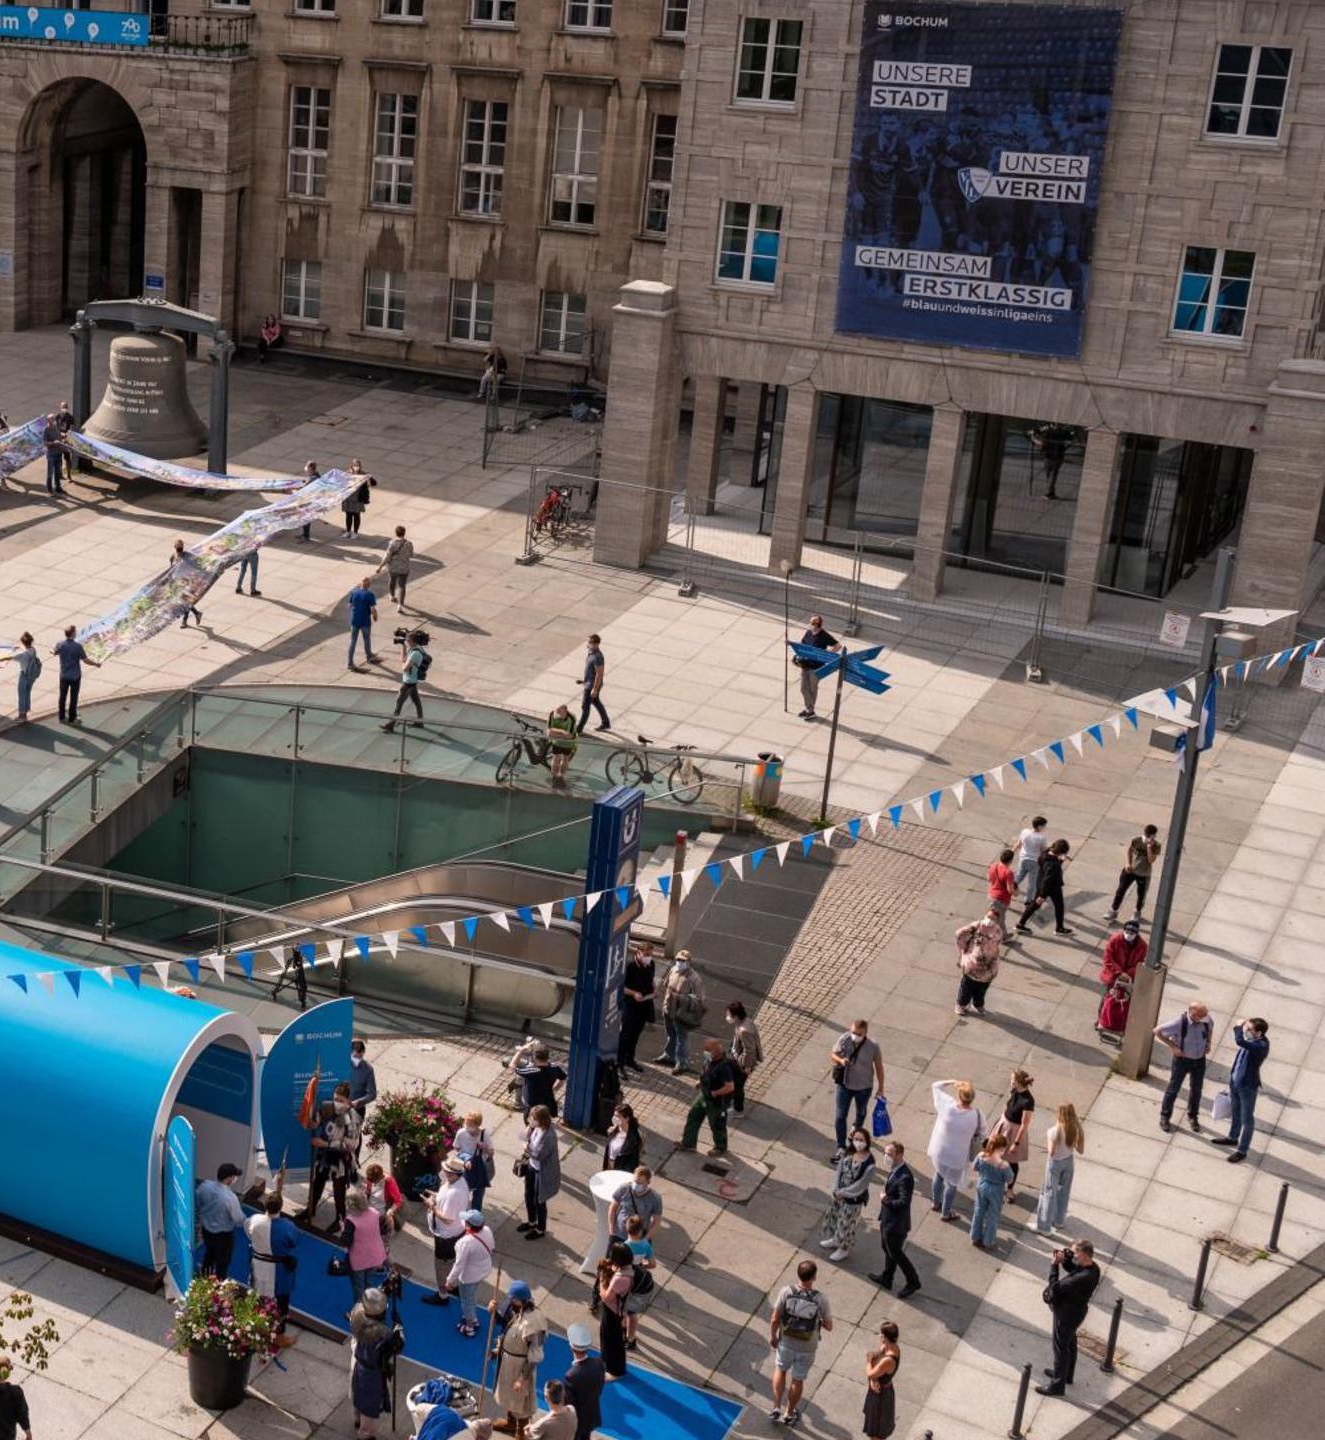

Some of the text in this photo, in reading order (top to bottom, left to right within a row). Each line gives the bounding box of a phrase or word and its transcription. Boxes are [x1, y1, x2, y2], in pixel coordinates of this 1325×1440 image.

[895, 15, 948, 28] BOCHUM
[877, 63, 968, 85] UNSERE
[872, 89, 944, 109] STADT
[1004, 155, 1083, 176] UNSER
[995, 180, 1082, 201] VEREIN
[859, 248, 989, 276] GEMEINSAM
[908, 277, 1066, 308] ERSTKLASSIG
[902, 299, 1053, 324] #blauundweissinligaeins
